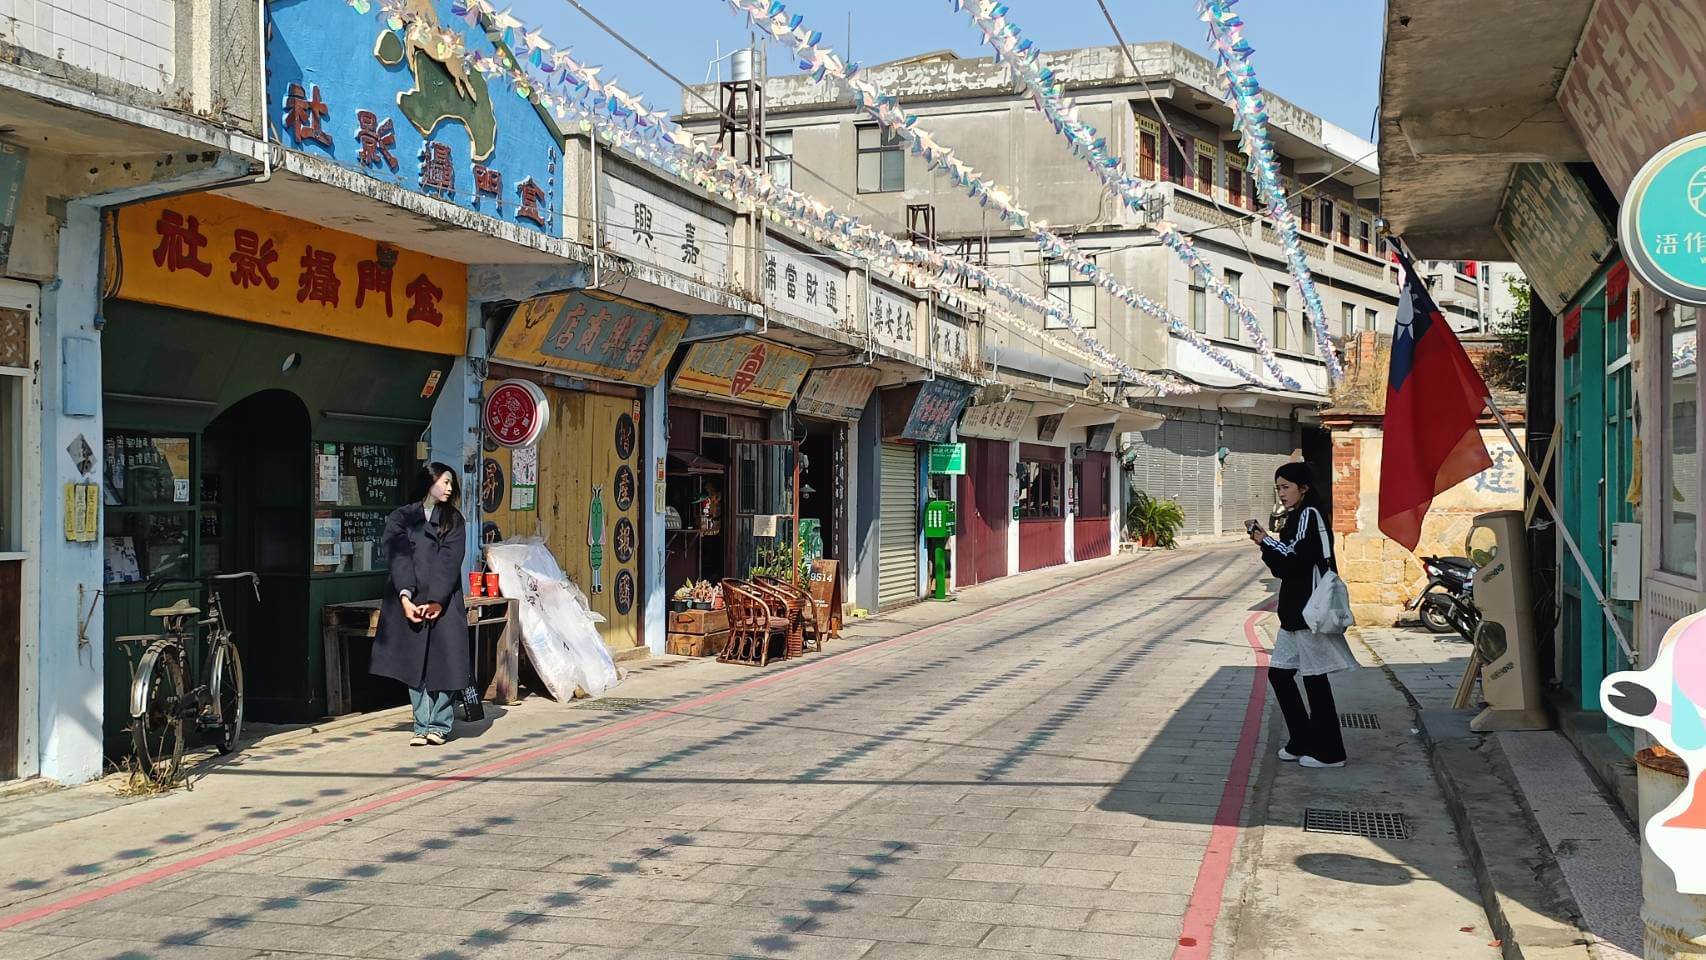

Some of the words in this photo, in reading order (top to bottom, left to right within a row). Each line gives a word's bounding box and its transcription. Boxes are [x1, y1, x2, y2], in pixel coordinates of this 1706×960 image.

[153, 210, 443, 327] 金門攝影社
